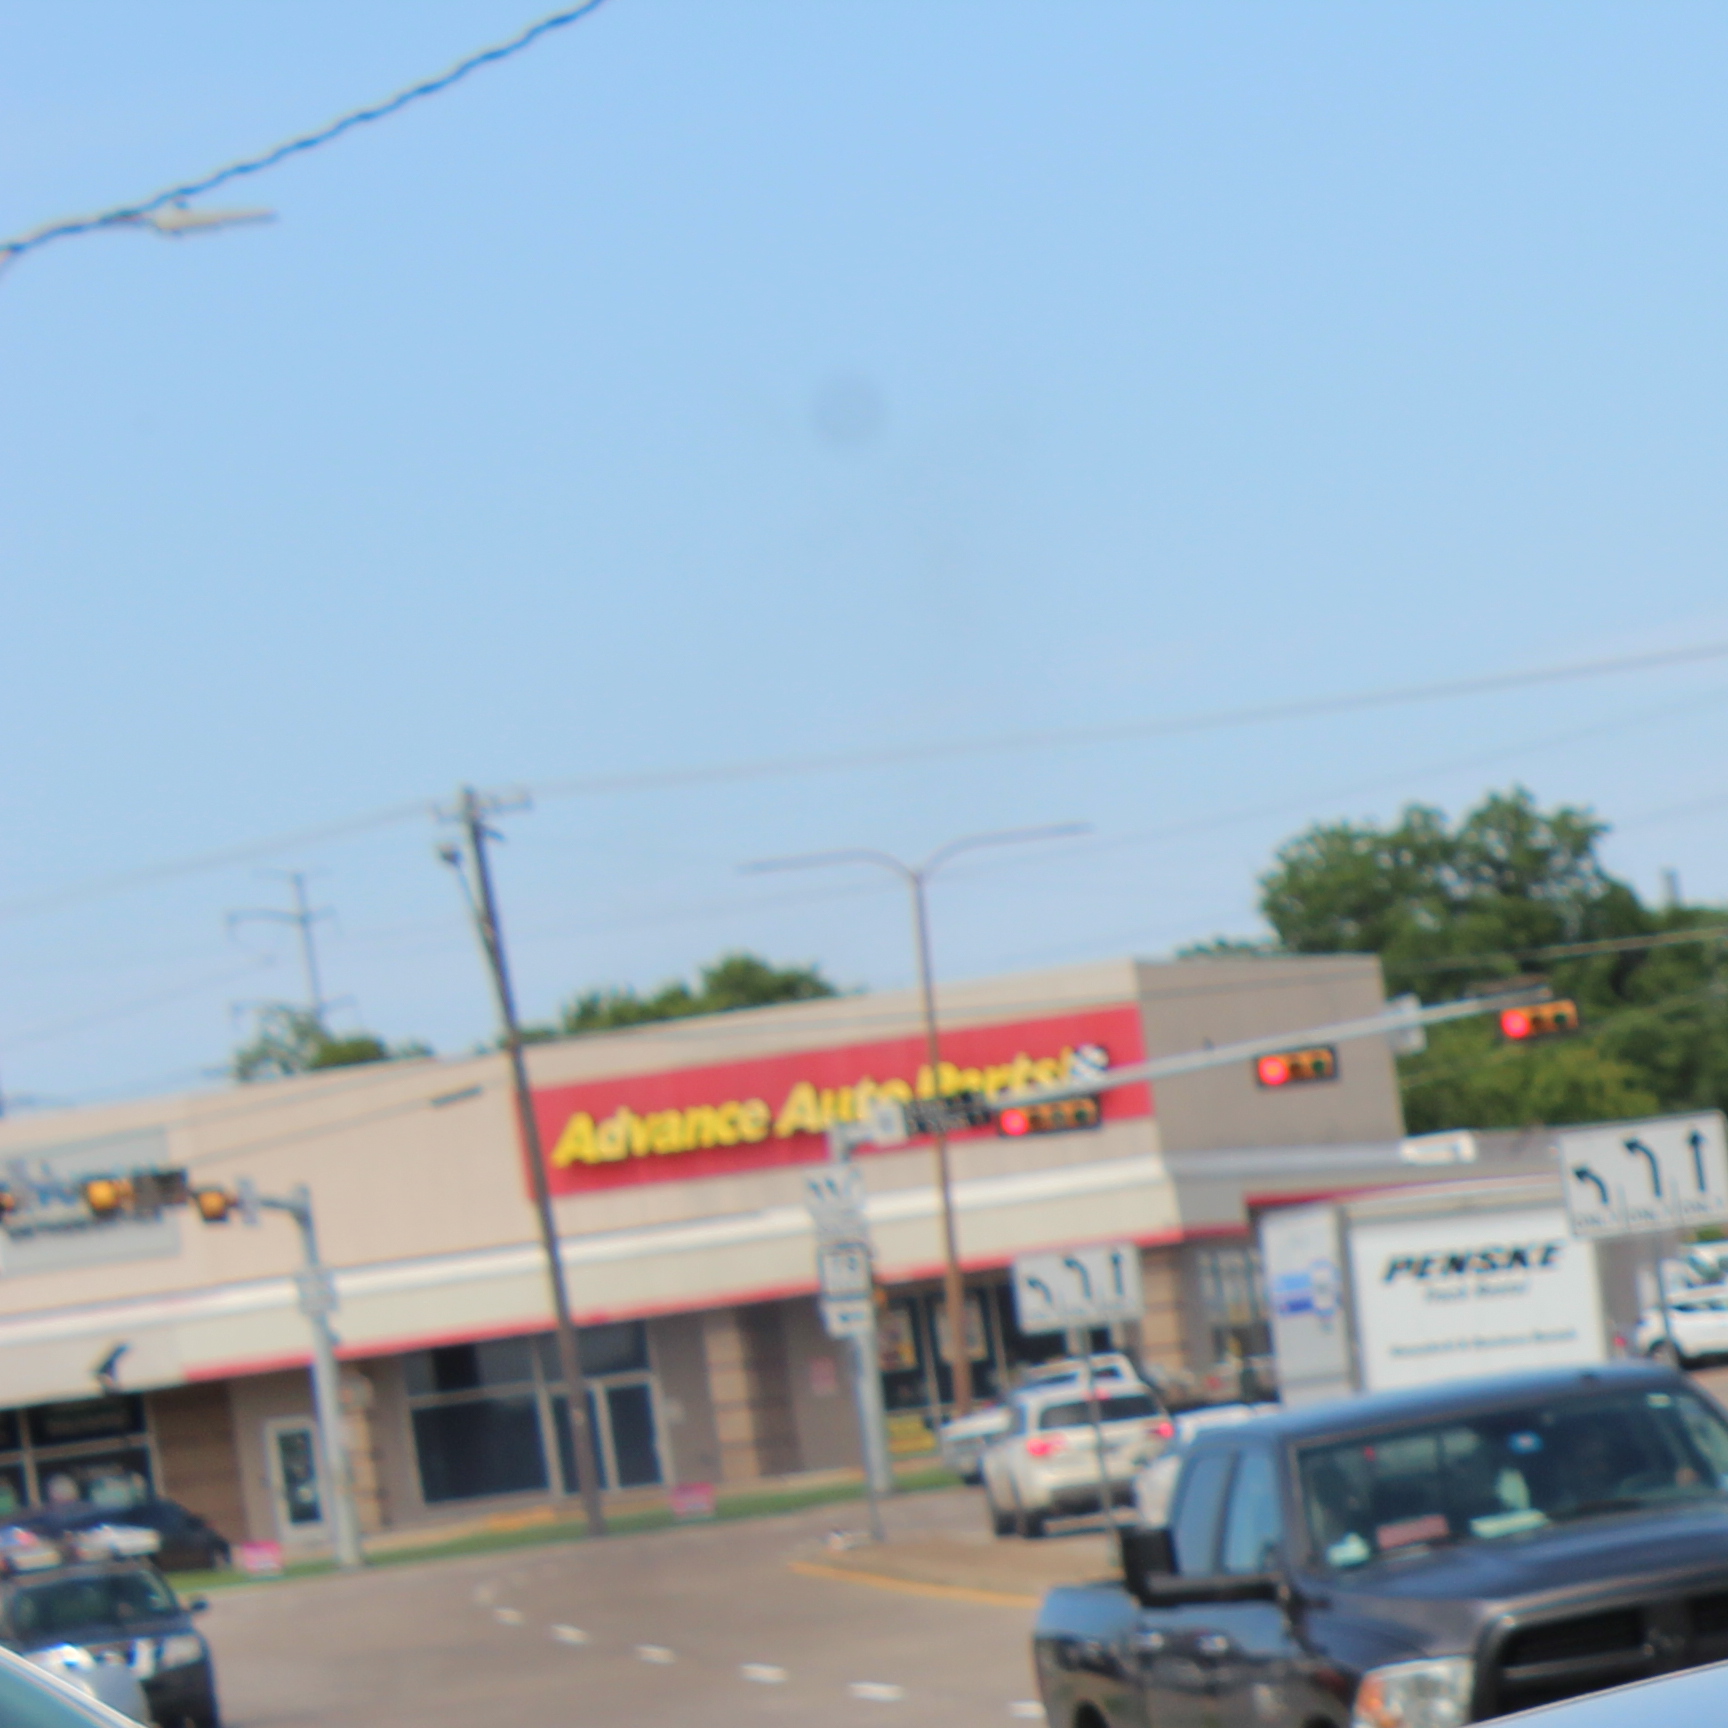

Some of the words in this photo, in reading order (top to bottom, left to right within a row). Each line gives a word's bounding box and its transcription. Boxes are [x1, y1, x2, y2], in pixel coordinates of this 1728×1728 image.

[552, 1097, 771, 1168] Advance
[774, 1074, 912, 1138] Auto
[1384, 1240, 1564, 1283] PENSKE
